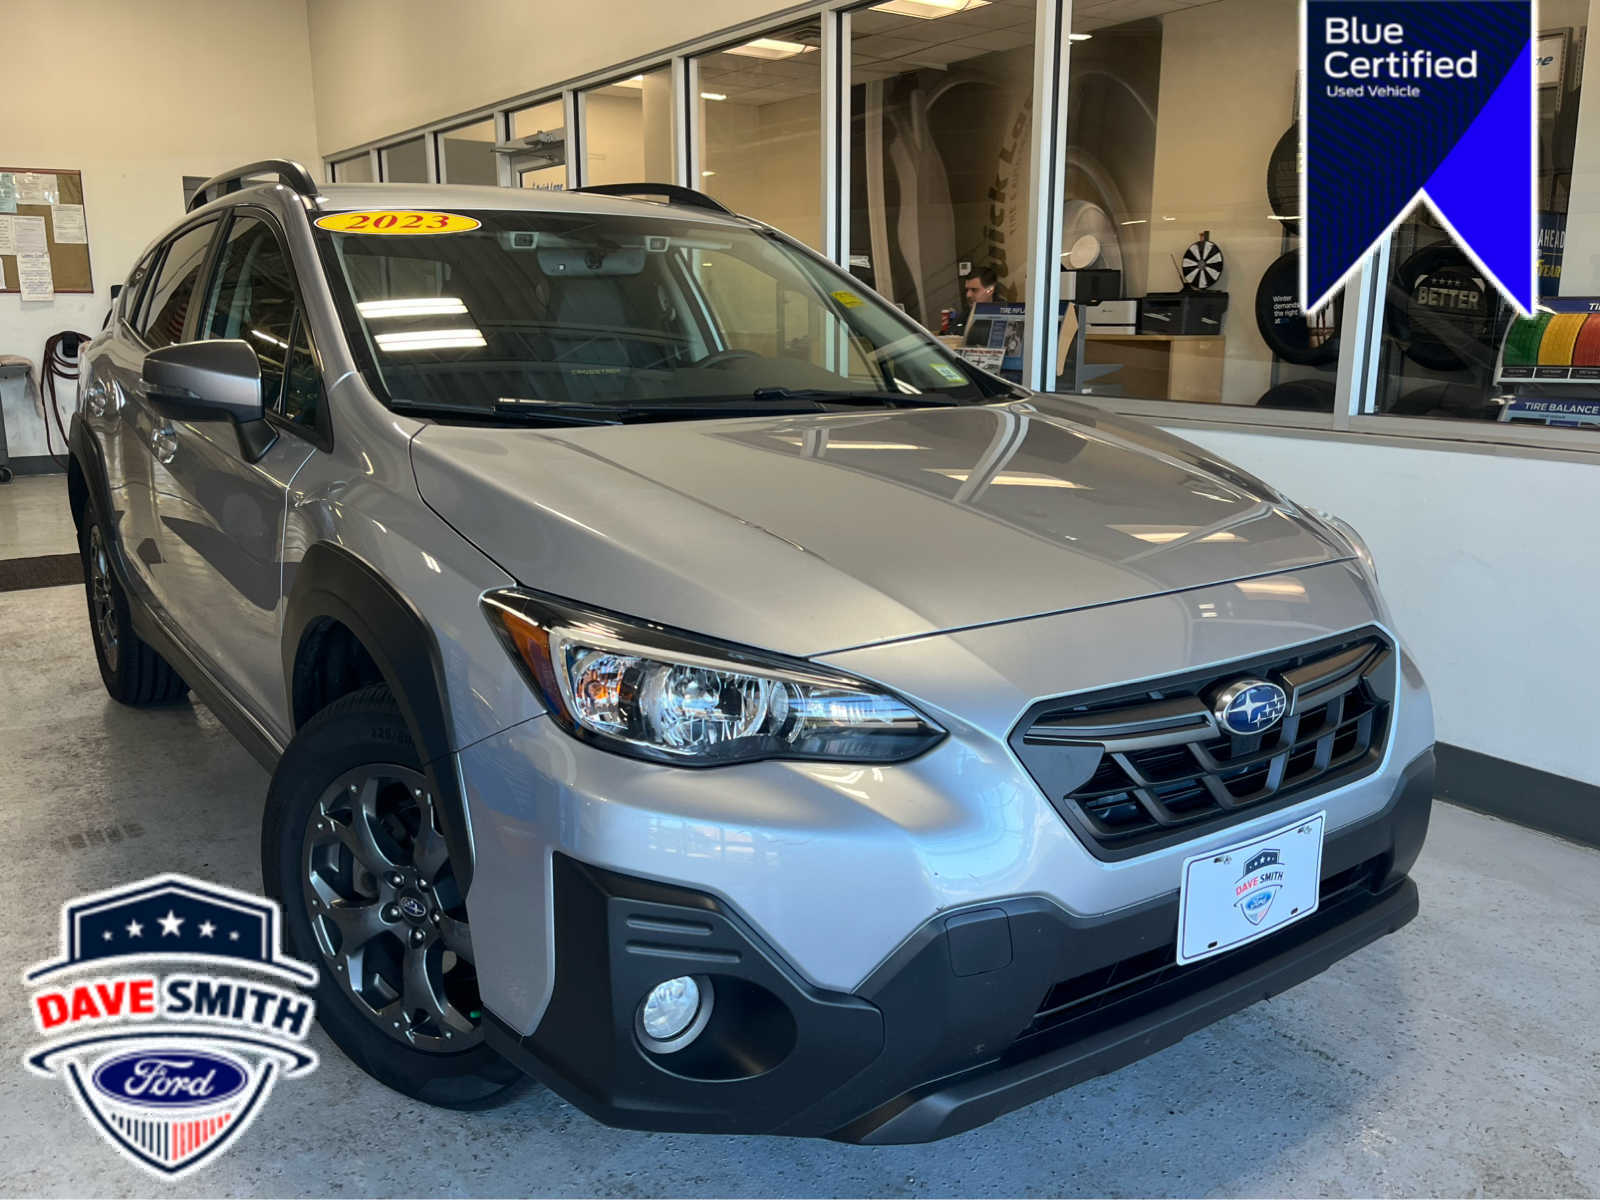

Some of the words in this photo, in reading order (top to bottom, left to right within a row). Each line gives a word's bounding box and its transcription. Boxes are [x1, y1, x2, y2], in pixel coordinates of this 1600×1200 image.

[345, 214, 449, 230] 2023
[1538, 228, 1566, 249] AHEAD
[1416, 286, 1480, 311] BETTER
[1525, 402, 1547, 411] TIRE
[1548, 402, 1599, 415] BALANCE
[1236, 876, 1259, 896] DAVE
[1259, 871, 1284, 884] SMITH
